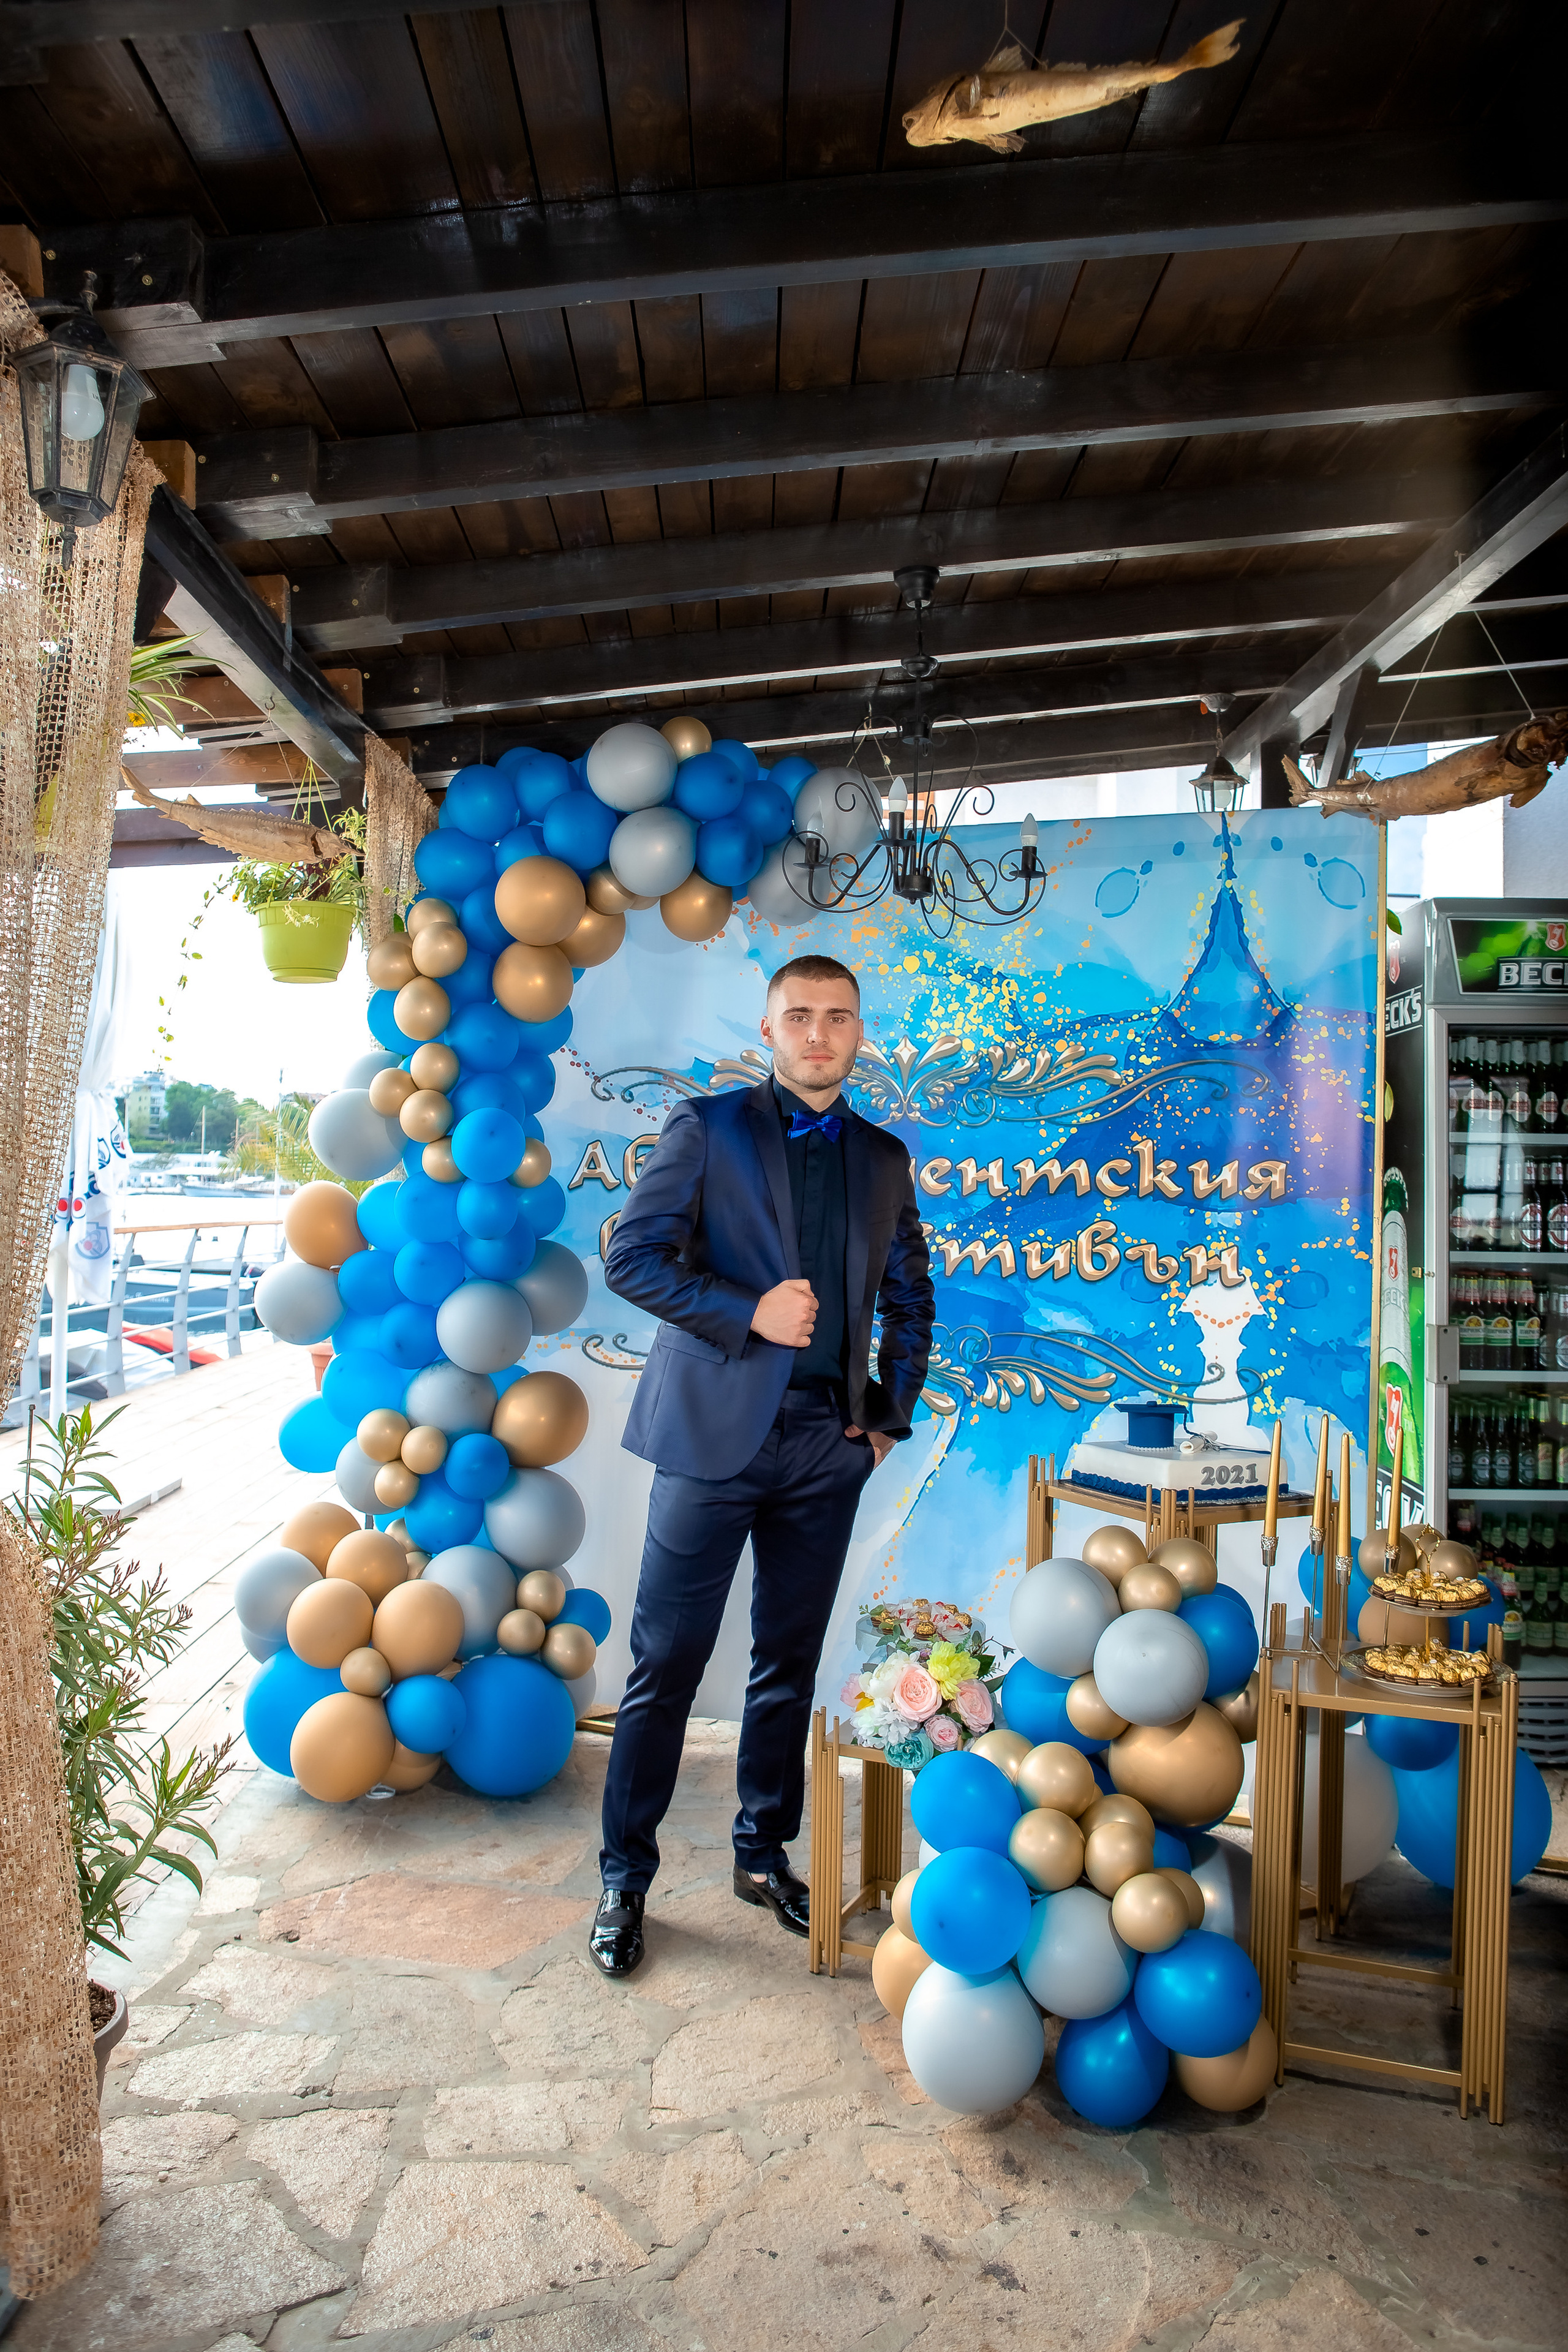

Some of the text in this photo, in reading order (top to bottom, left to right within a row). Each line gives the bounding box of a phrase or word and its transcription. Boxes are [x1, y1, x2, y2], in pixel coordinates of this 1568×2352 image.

[1498, 962, 1568, 986] BEC
[1385, 988, 1422, 1031] ECK'S
[920, 1220, 1246, 1287] тивън
[1200, 1463, 1259, 1486] 2021
